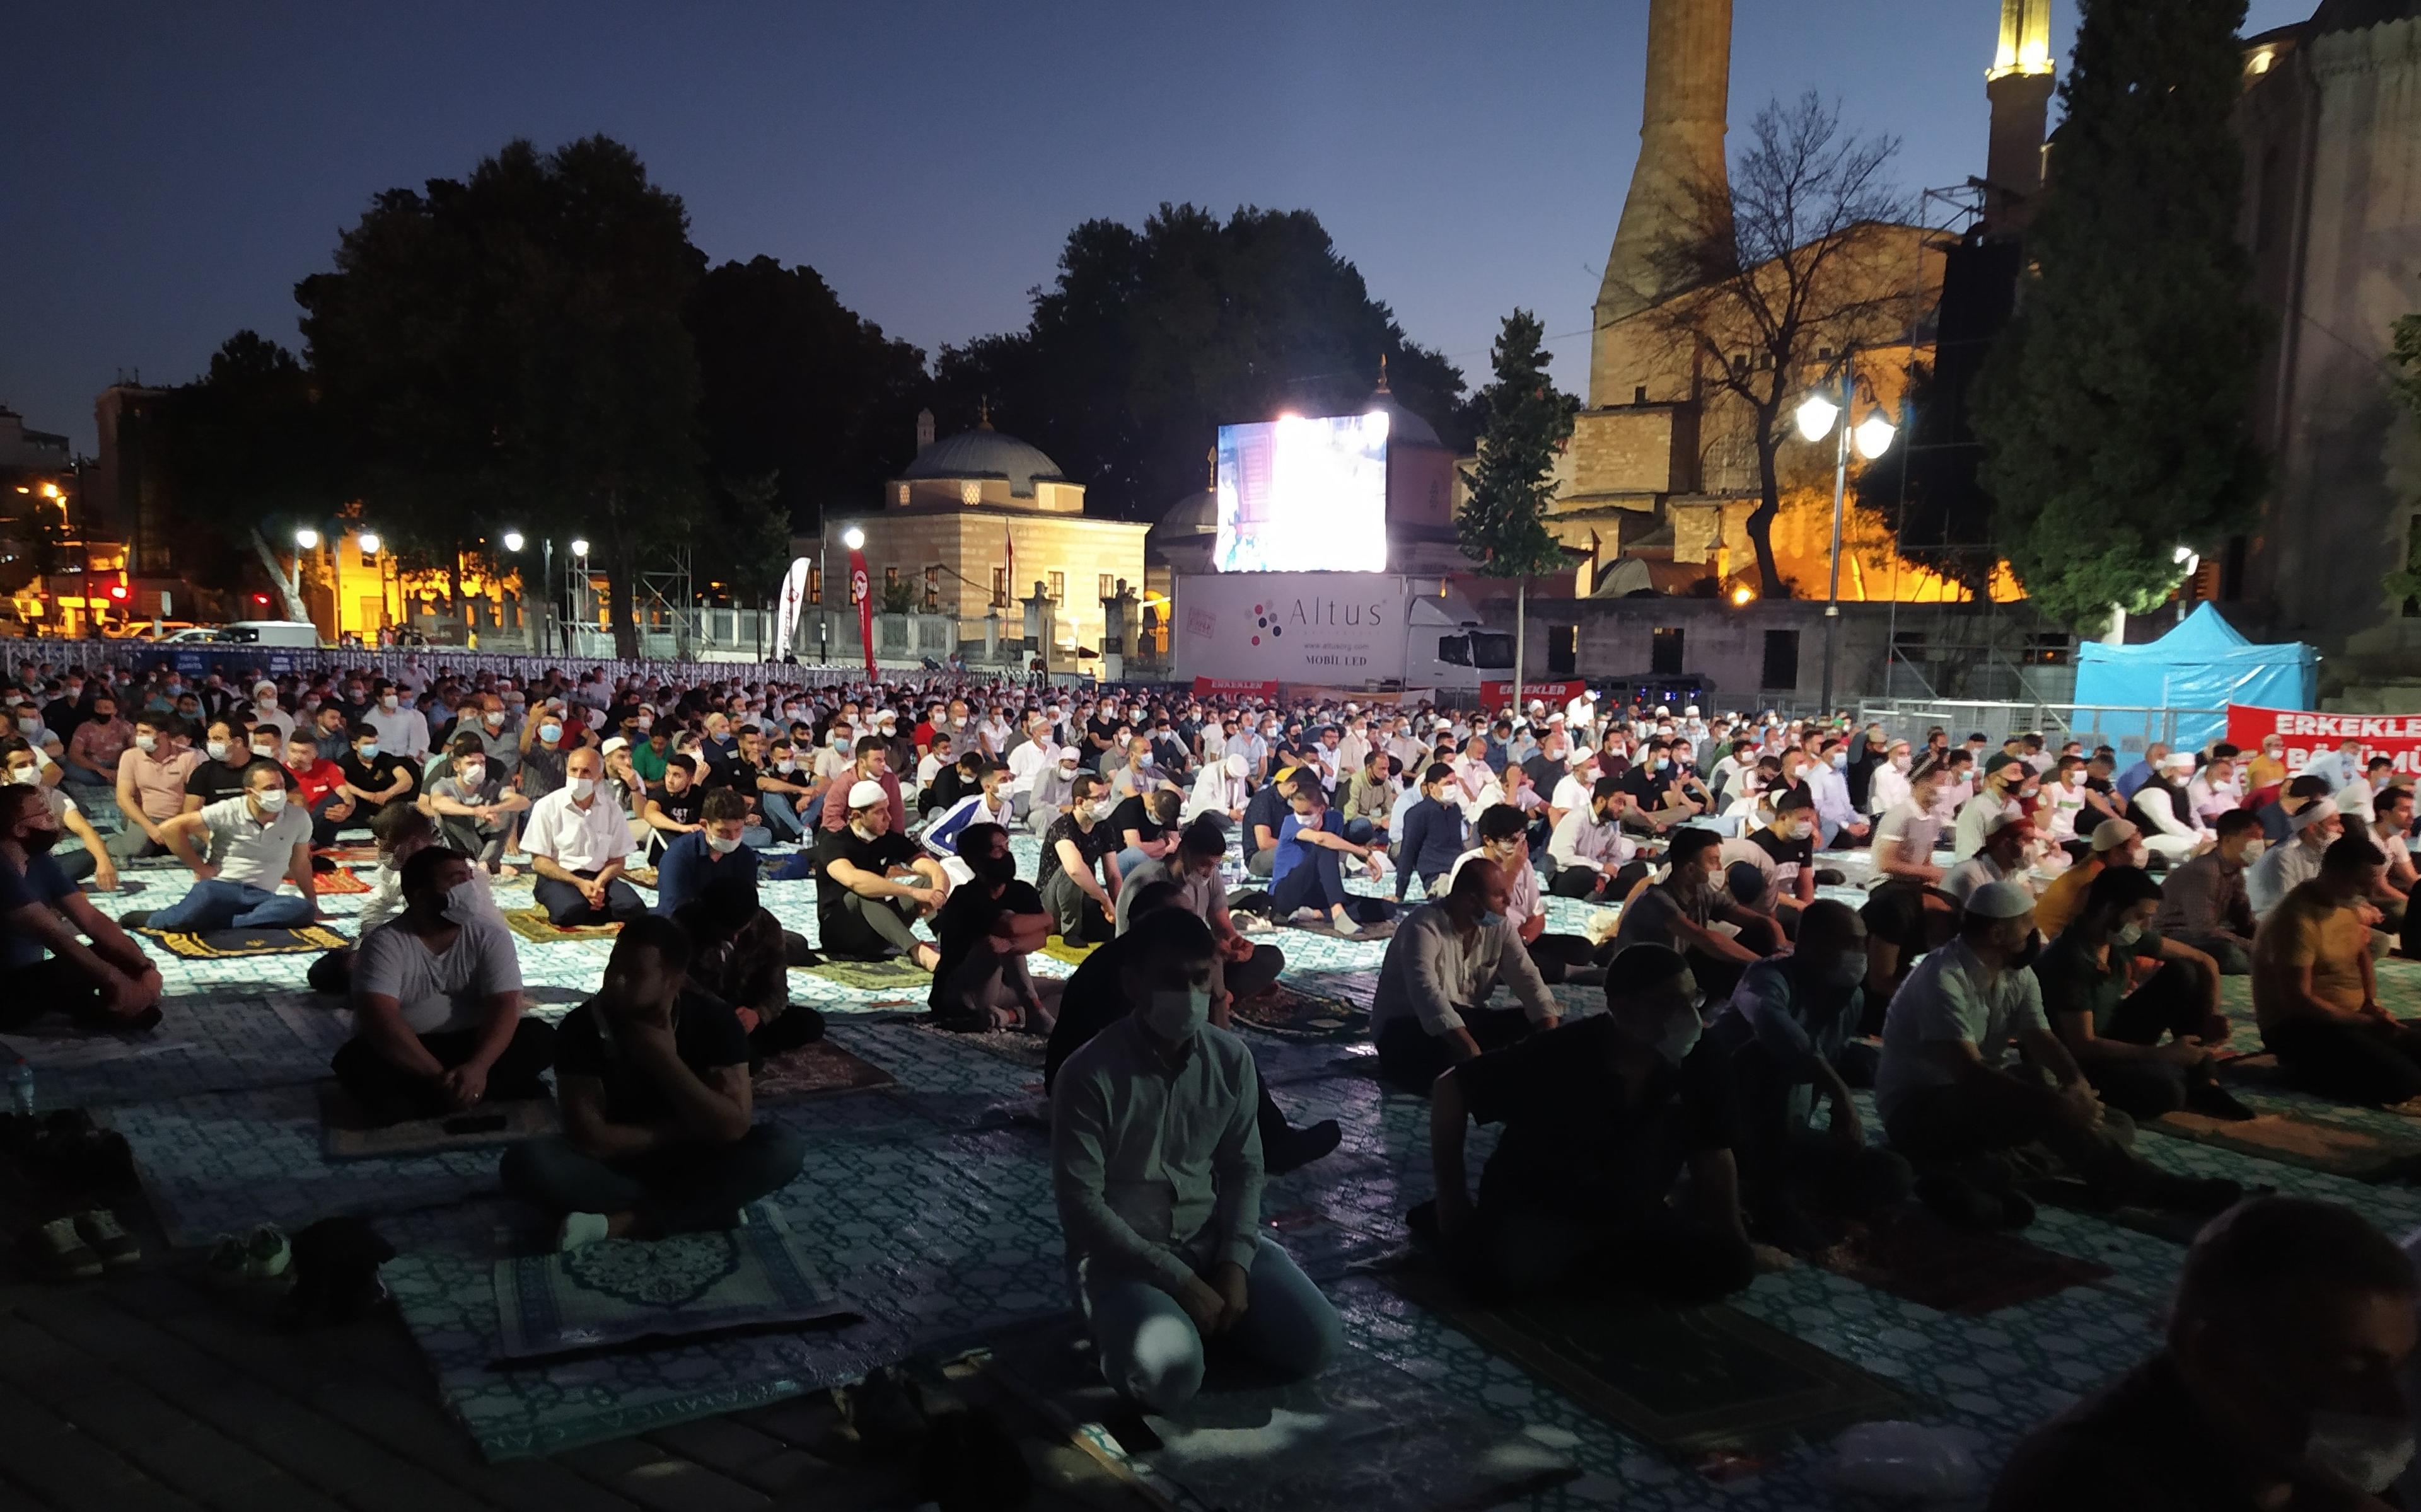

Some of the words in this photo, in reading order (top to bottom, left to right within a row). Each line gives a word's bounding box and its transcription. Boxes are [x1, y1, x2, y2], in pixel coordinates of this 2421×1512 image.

[1290, 596, 1381, 626] Altus
[1345, 657, 1367, 666] LED
[1499, 684, 1567, 695] EREKLER
